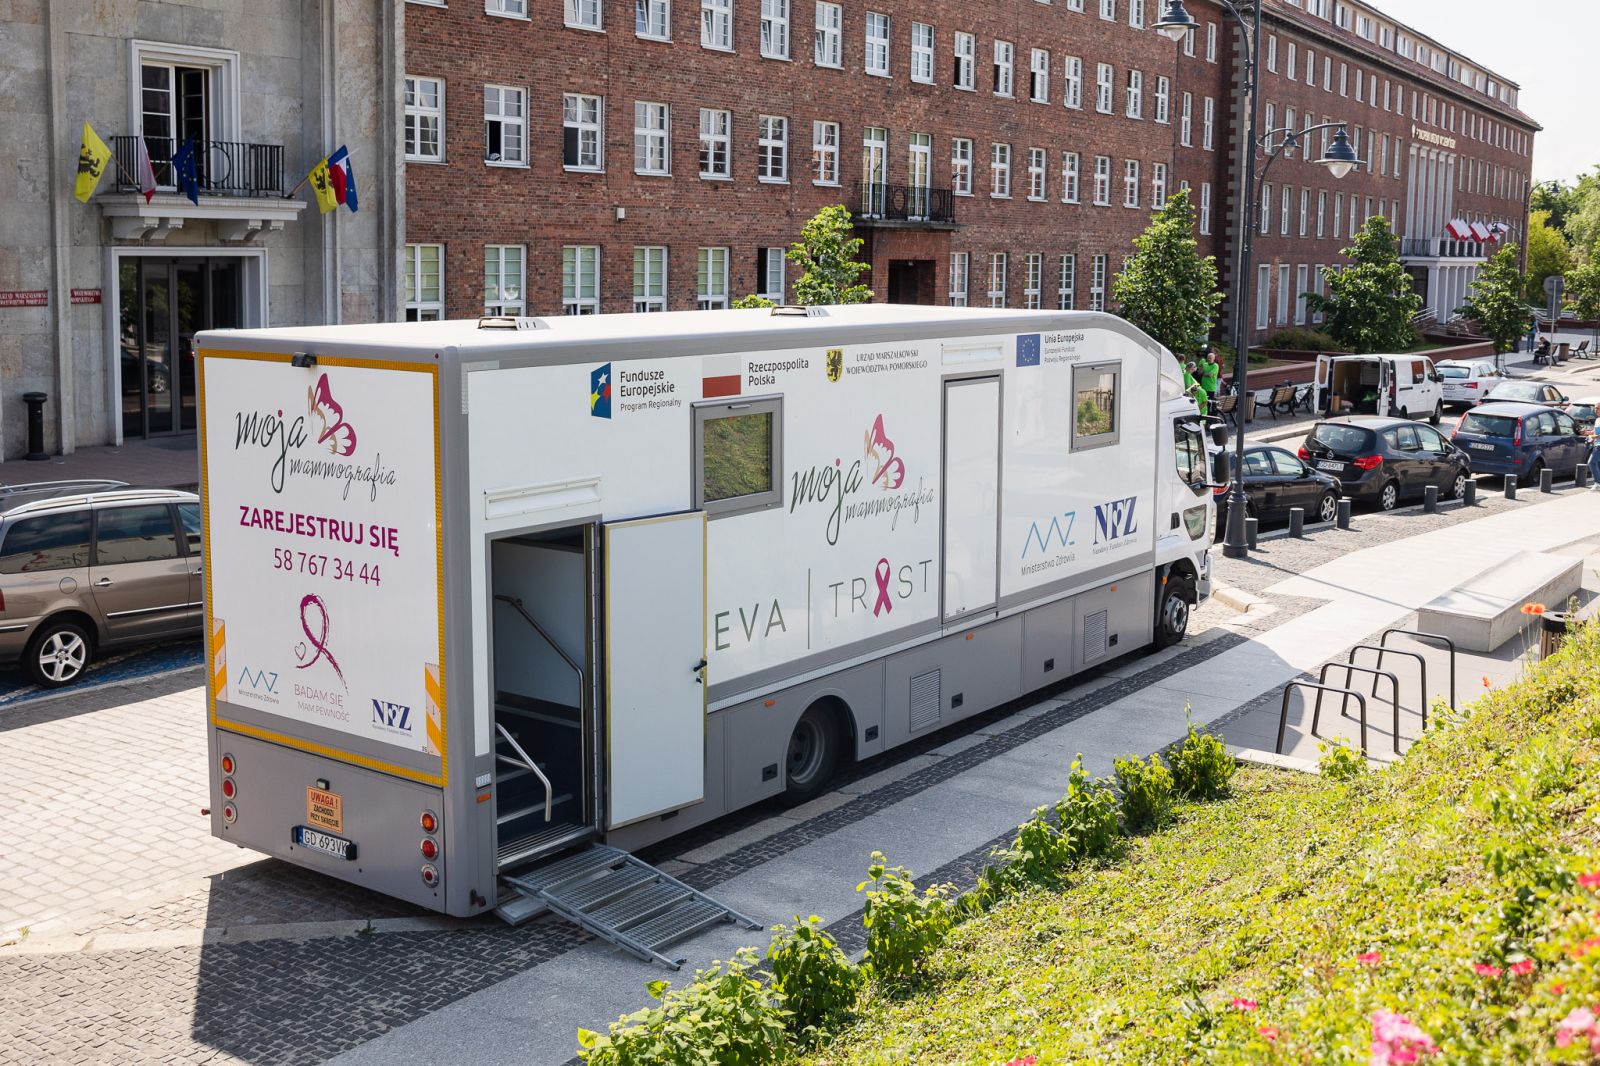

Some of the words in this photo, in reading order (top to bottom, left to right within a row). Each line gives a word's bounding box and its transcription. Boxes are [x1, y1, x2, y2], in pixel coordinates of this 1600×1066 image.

[1045, 334, 1056, 344] Unia
[1057, 332, 1084, 344] Europejska
[620, 370, 664, 383] Fundusze
[749, 357, 809, 375] Rzeczpospolita
[889, 360, 928, 371] POMORSKIEGO
[620, 381, 675, 398] Europejskie
[749, 374, 776, 387] Polska
[620, 401, 647, 413] Program
[648, 398, 682, 411] Regionalny
[235, 409, 308, 494] moja
[290, 452, 397, 503] mammografia
[790, 457, 863, 546] moja
[845, 476, 935, 532] mammografia
[239, 505, 364, 545] ZAREJESTRUJ
[369, 524, 399, 557] SIĘ
[1092, 495, 1138, 546] NFZ
[273, 547, 293, 571] 58
[297, 551, 328, 577] 767
[333, 557, 354, 582] 34
[359, 562, 381, 587] 44
[1021, 558, 1055, 577] Ministerstwo
[1055, 552, 1076, 567] Zdrowia
[714, 598, 787, 651] EVA
[294, 683, 328, 703] BADAM
[329, 692, 344, 708] SIĘ
[297, 701, 315, 713] MAM
[371, 698, 412, 731] NFZ
[310, 791, 334, 807] UWAGA
[304, 830, 317, 846] GD
[319, 835, 348, 857] 693VK
